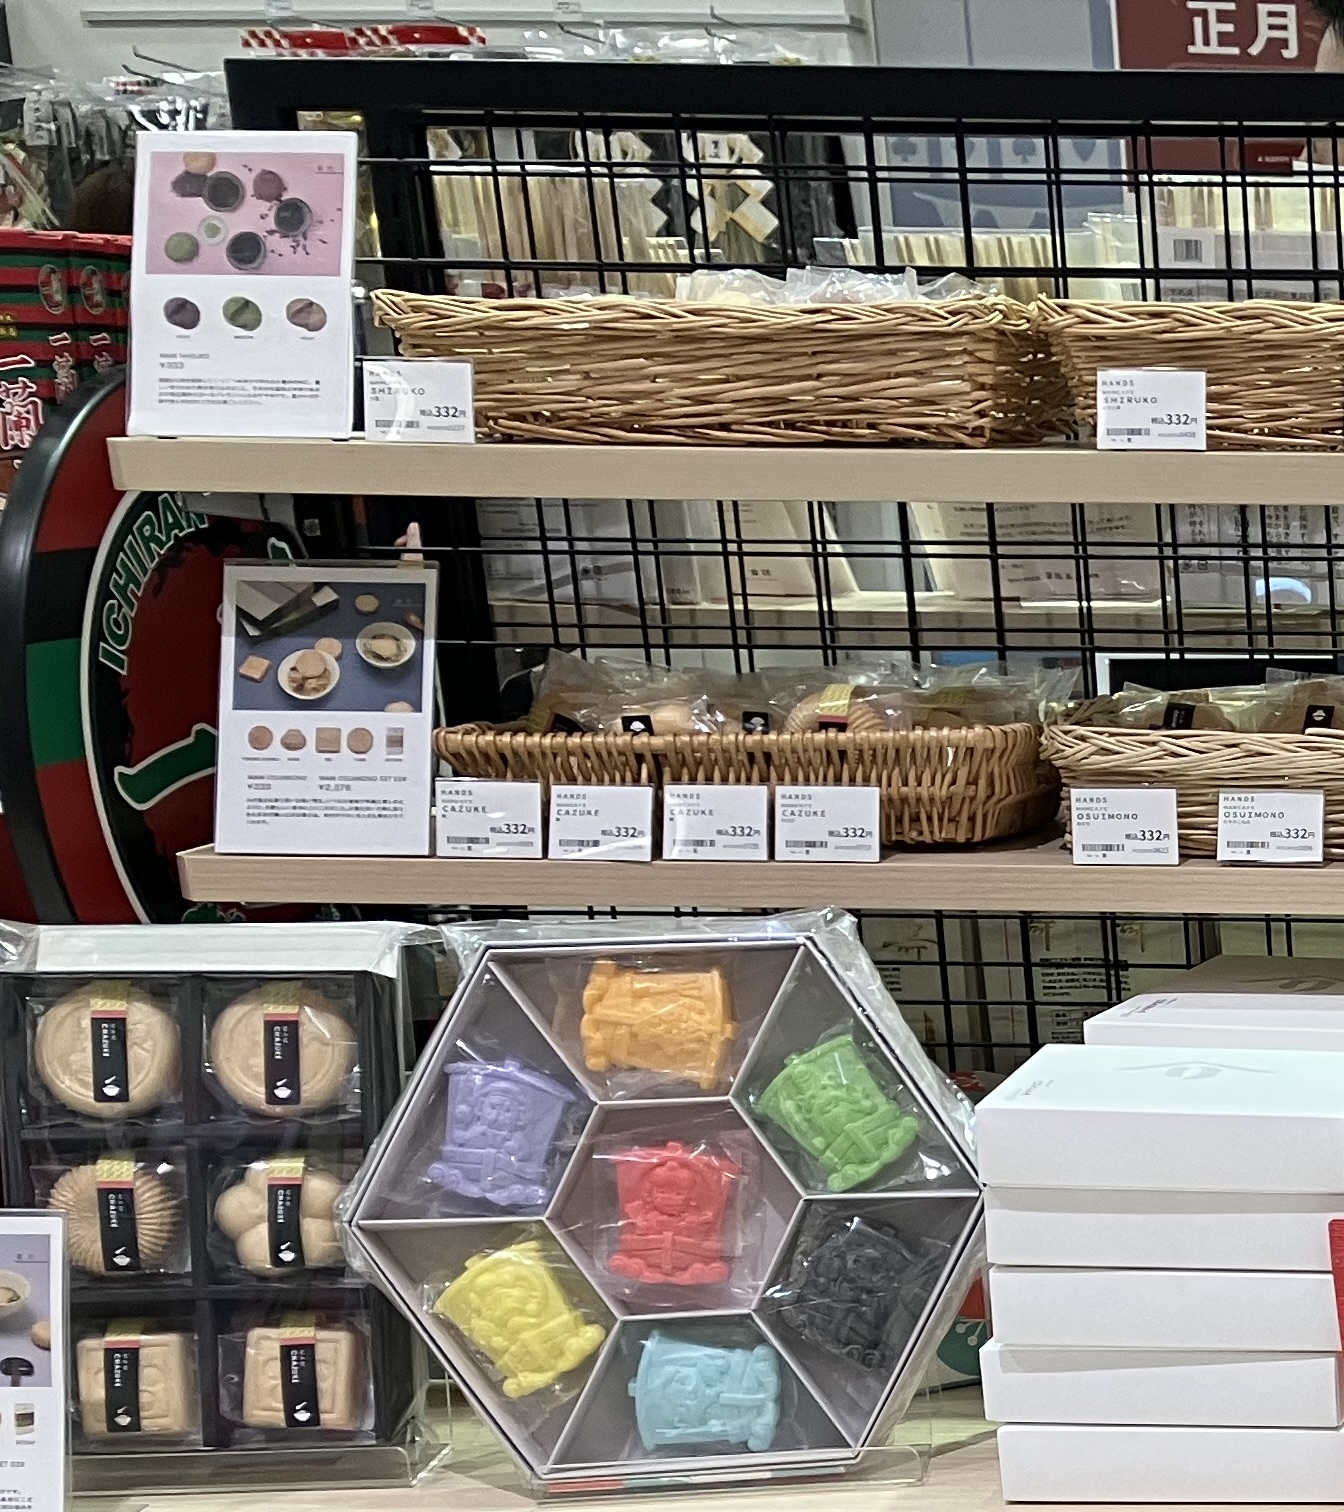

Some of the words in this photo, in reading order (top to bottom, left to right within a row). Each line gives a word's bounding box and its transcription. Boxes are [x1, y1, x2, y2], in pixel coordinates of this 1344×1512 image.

[1187, 2, 1300, 59] 正月
[442, 805, 488, 813] CAZUKE
[557, 809, 600, 817] CAZUKE
[669, 808, 715, 816] CAZUKE
[781, 809, 826, 818] CAZUKE
[1224, 811, 1285, 819] OSUIMONO
